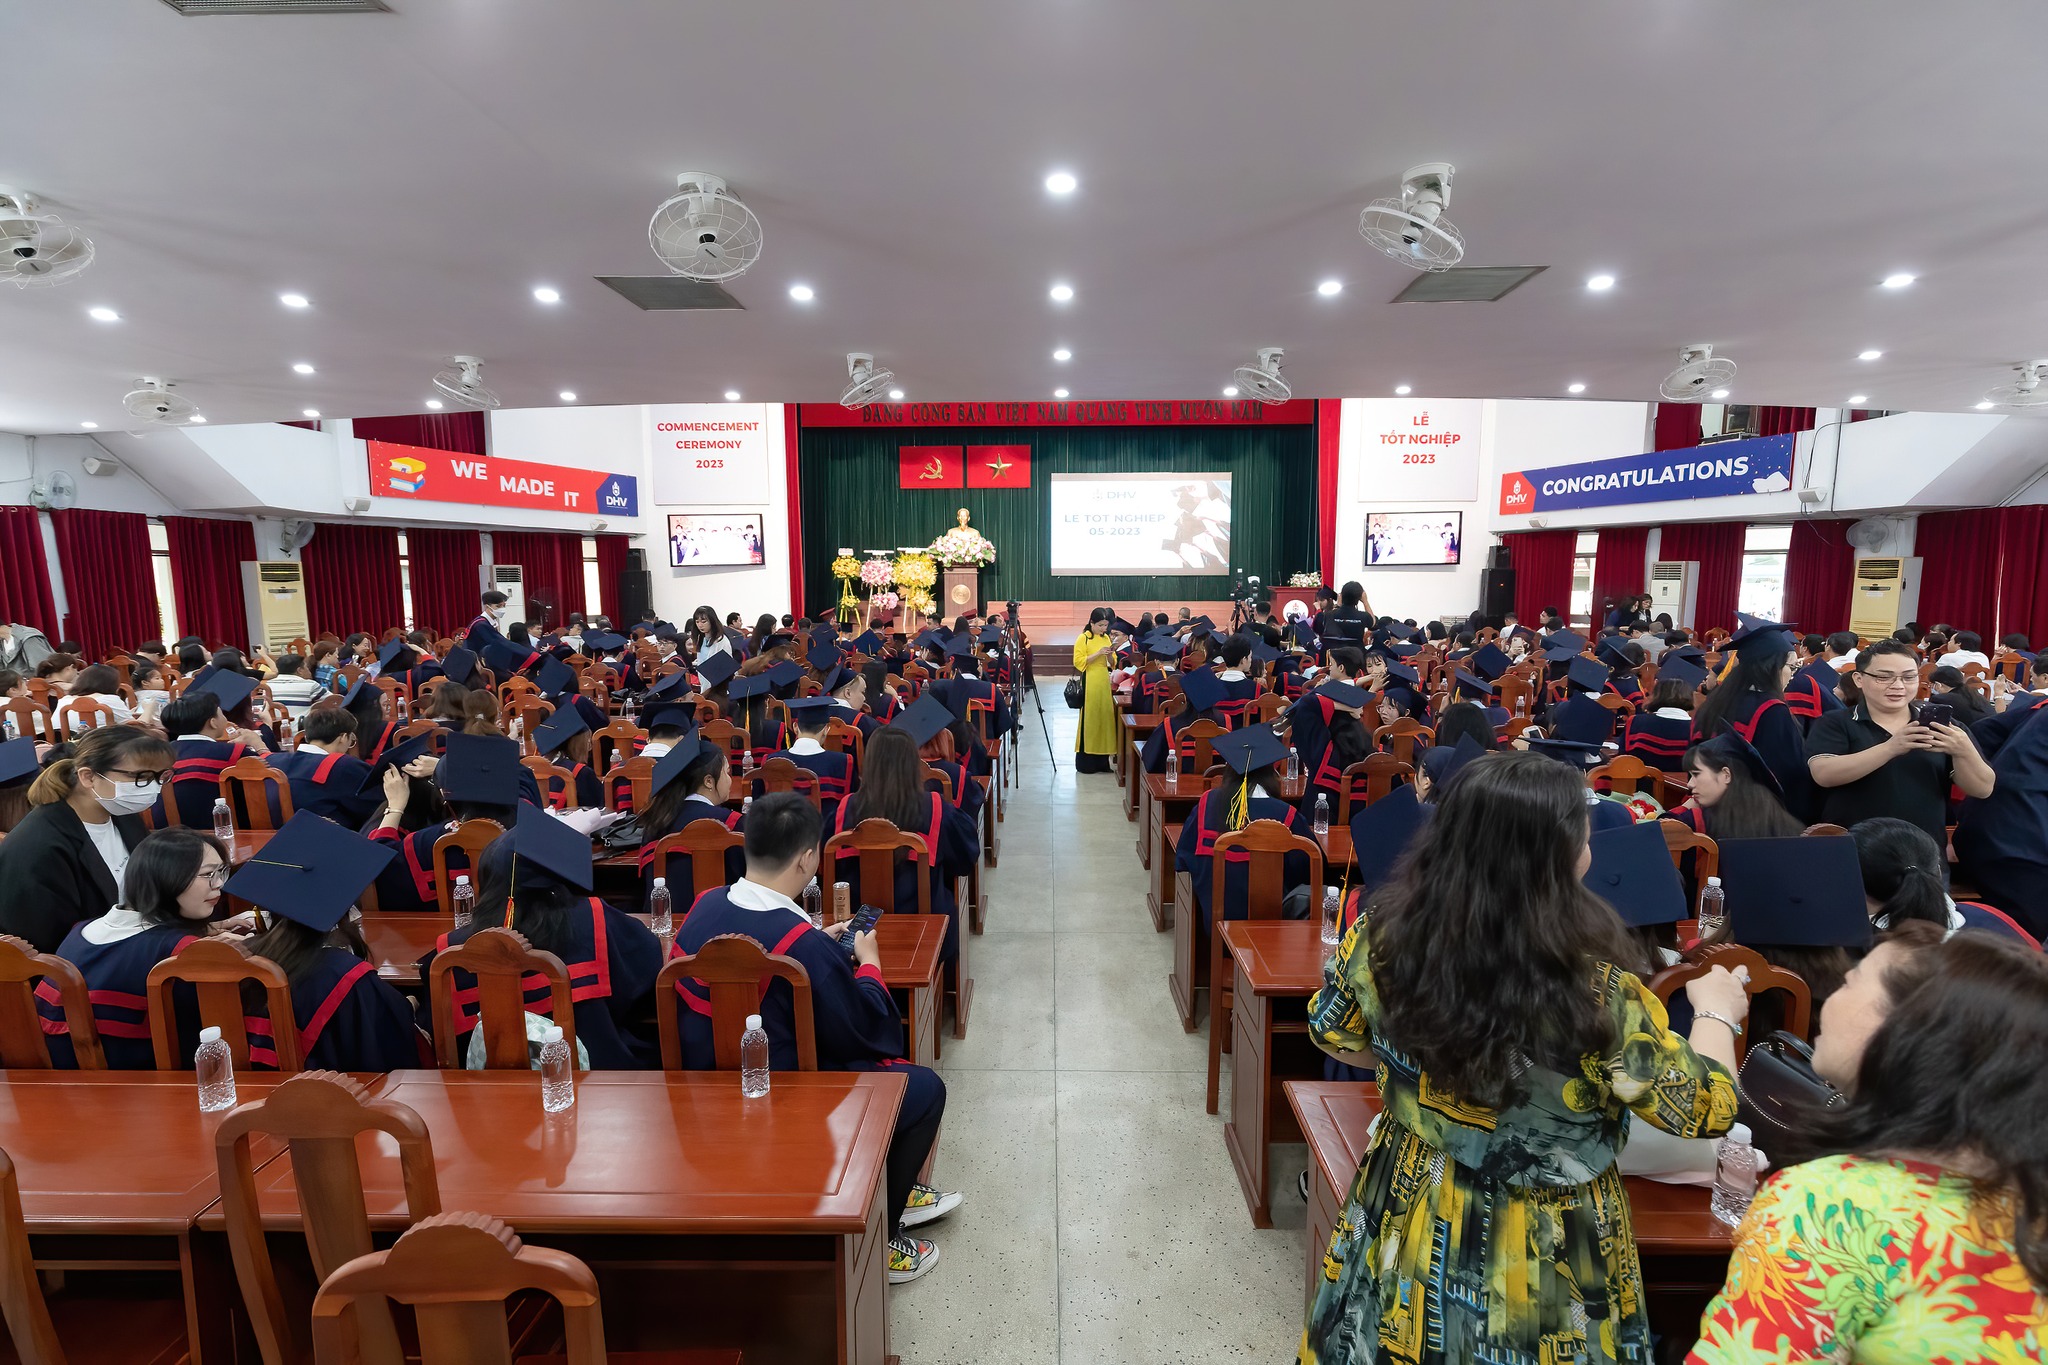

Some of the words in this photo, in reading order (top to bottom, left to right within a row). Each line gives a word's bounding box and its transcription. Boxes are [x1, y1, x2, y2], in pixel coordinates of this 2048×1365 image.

[1037, 403, 1069, 422] NAM
[1075, 402, 1127, 422] QUANG
[1135, 402, 1172, 421] VINH
[1413, 411, 1430, 426] LỄ
[657, 422, 759, 432] COMMENCEMENT
[1380, 429, 1406, 444] TỐT
[1409, 431, 1461, 448] NGHIỆP
[676, 440, 742, 450] CEREMONY
[695, 459, 724, 469] 2023
[1402, 454, 1436, 464] 2023
[1542, 456, 1749, 496] CONGRATULATIONS
[450, 459, 488, 480] WE
[499, 475, 555, 497] MADE
[564, 491, 580, 507] IT
[1107, 491, 1137, 499] DHV
[1506, 493, 1528, 504] DHV
[605, 495, 628, 507] DHV
[1089, 527, 1141, 536] 05-2023
